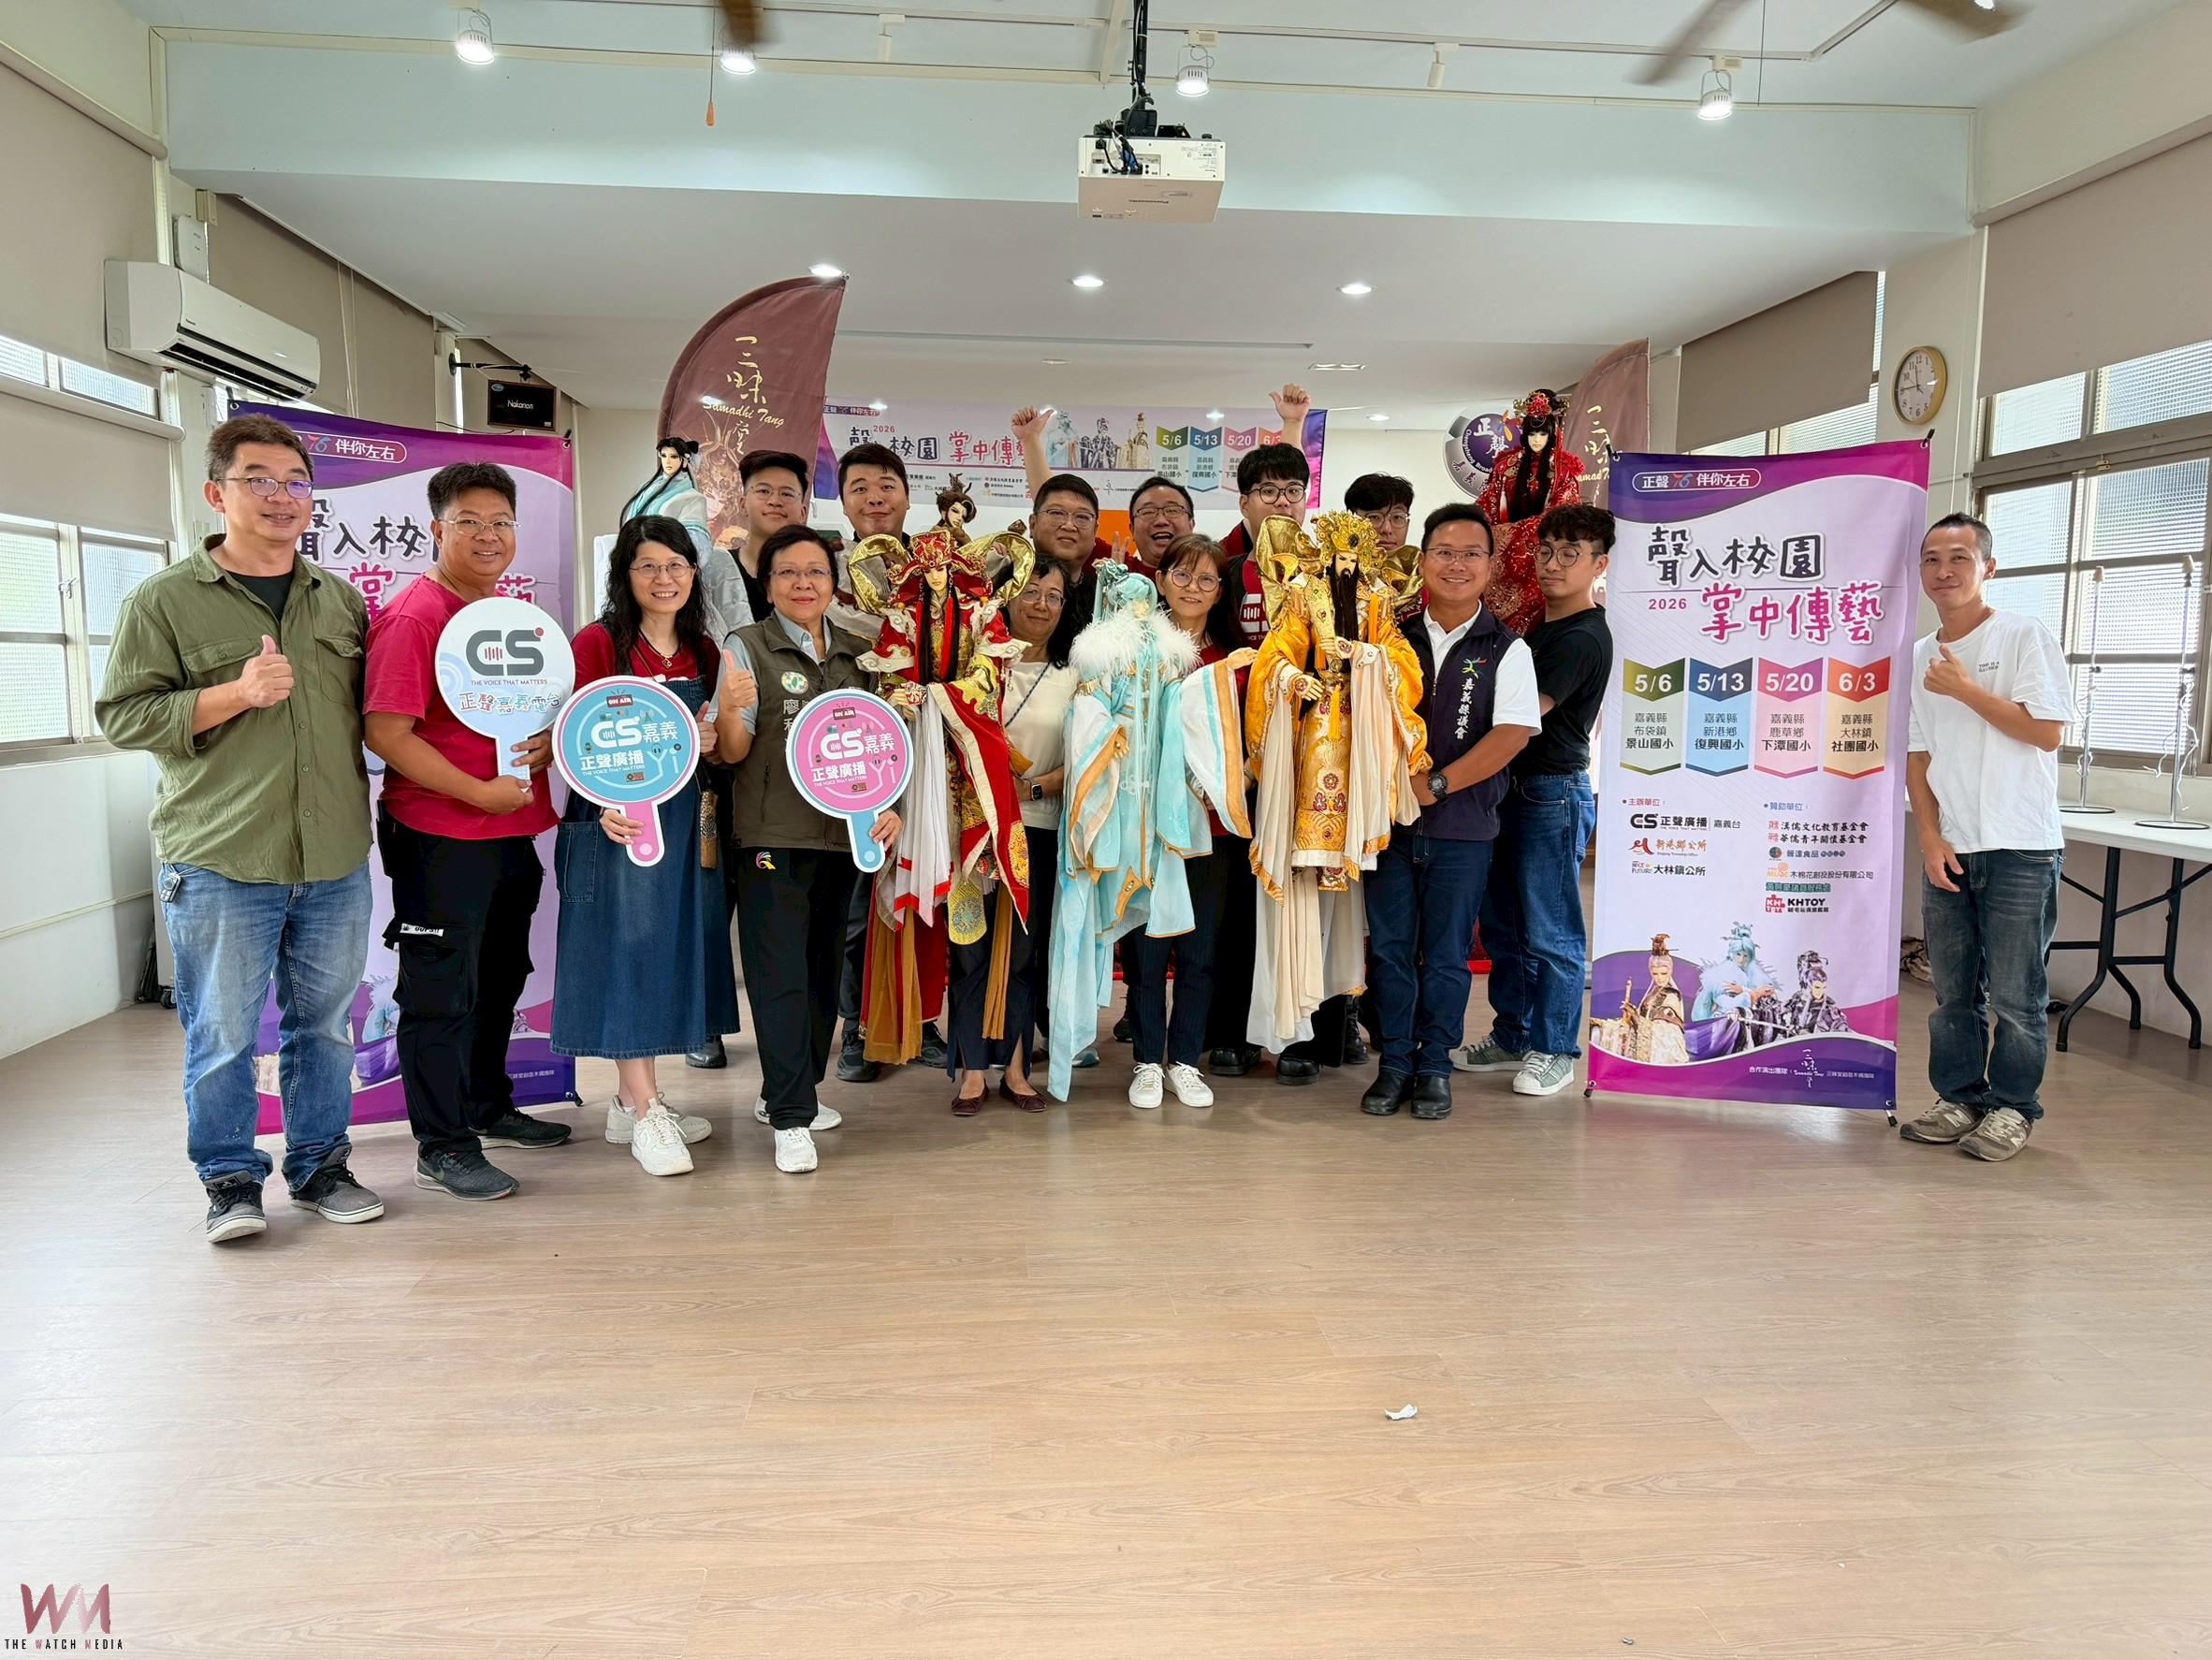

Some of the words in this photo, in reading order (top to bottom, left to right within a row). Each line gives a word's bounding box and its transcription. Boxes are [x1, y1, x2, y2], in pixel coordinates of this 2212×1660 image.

[703, 402, 753, 419] Samadhi
[758, 408, 785, 428] Tang
[873, 425, 895, 433] 2026
[850, 427, 938, 460] 聲校園
[1162, 434, 1182, 445] 5/6
[1193, 434, 1218, 446] 5/13
[1228, 434, 1252, 446] 5/20
[335, 438, 396, 461] 伴你左右
[1642, 475, 1669, 488] 正聲
[1696, 473, 1751, 488] 伴你左右
[298, 499, 438, 561] 聲入校
[1648, 526, 1822, 586] 聲入校園
[1649, 598, 1687, 610] 2026
[1701, 582, 1883, 642] 掌中傳藝
[466, 628, 545, 677] CS
[1634, 674, 1672, 692] 5/6
[1696, 672, 1745, 692] 5/13
[1765, 672, 1814, 692] 5/20
[1838, 673, 1876, 692] 6/3
[458, 692, 562, 714] 正聲嘉義電台
[1635, 713, 1667, 723] 嘉義縣
[1704, 713, 1738, 723] 嘉義縣
[1771, 713, 1805, 724] 嘉義縣
[1841, 714, 1873, 725] 嘉義縣
[590, 717, 643, 749] CS
[642, 721, 678, 744] 嘉義
[1840, 728, 1872, 738] 大林鎮
[820, 728, 865, 760] CS
[864, 733, 895, 754] 嘉義
[1625, 738, 1674, 749] 景山國小
[1695, 739, 1744, 750] 復興國小
[1762, 740, 1812, 751] 下潭國小
[580, 750, 645, 771] 正聲廣播
[811, 760, 866, 782] 正聲廣播
[1630, 813, 1658, 829] CS
[1660, 816, 1708, 827] 正聲廣播
[1653, 865, 1707, 877] 大林鎮公所
[1787, 898, 1826, 907] KHTOY
